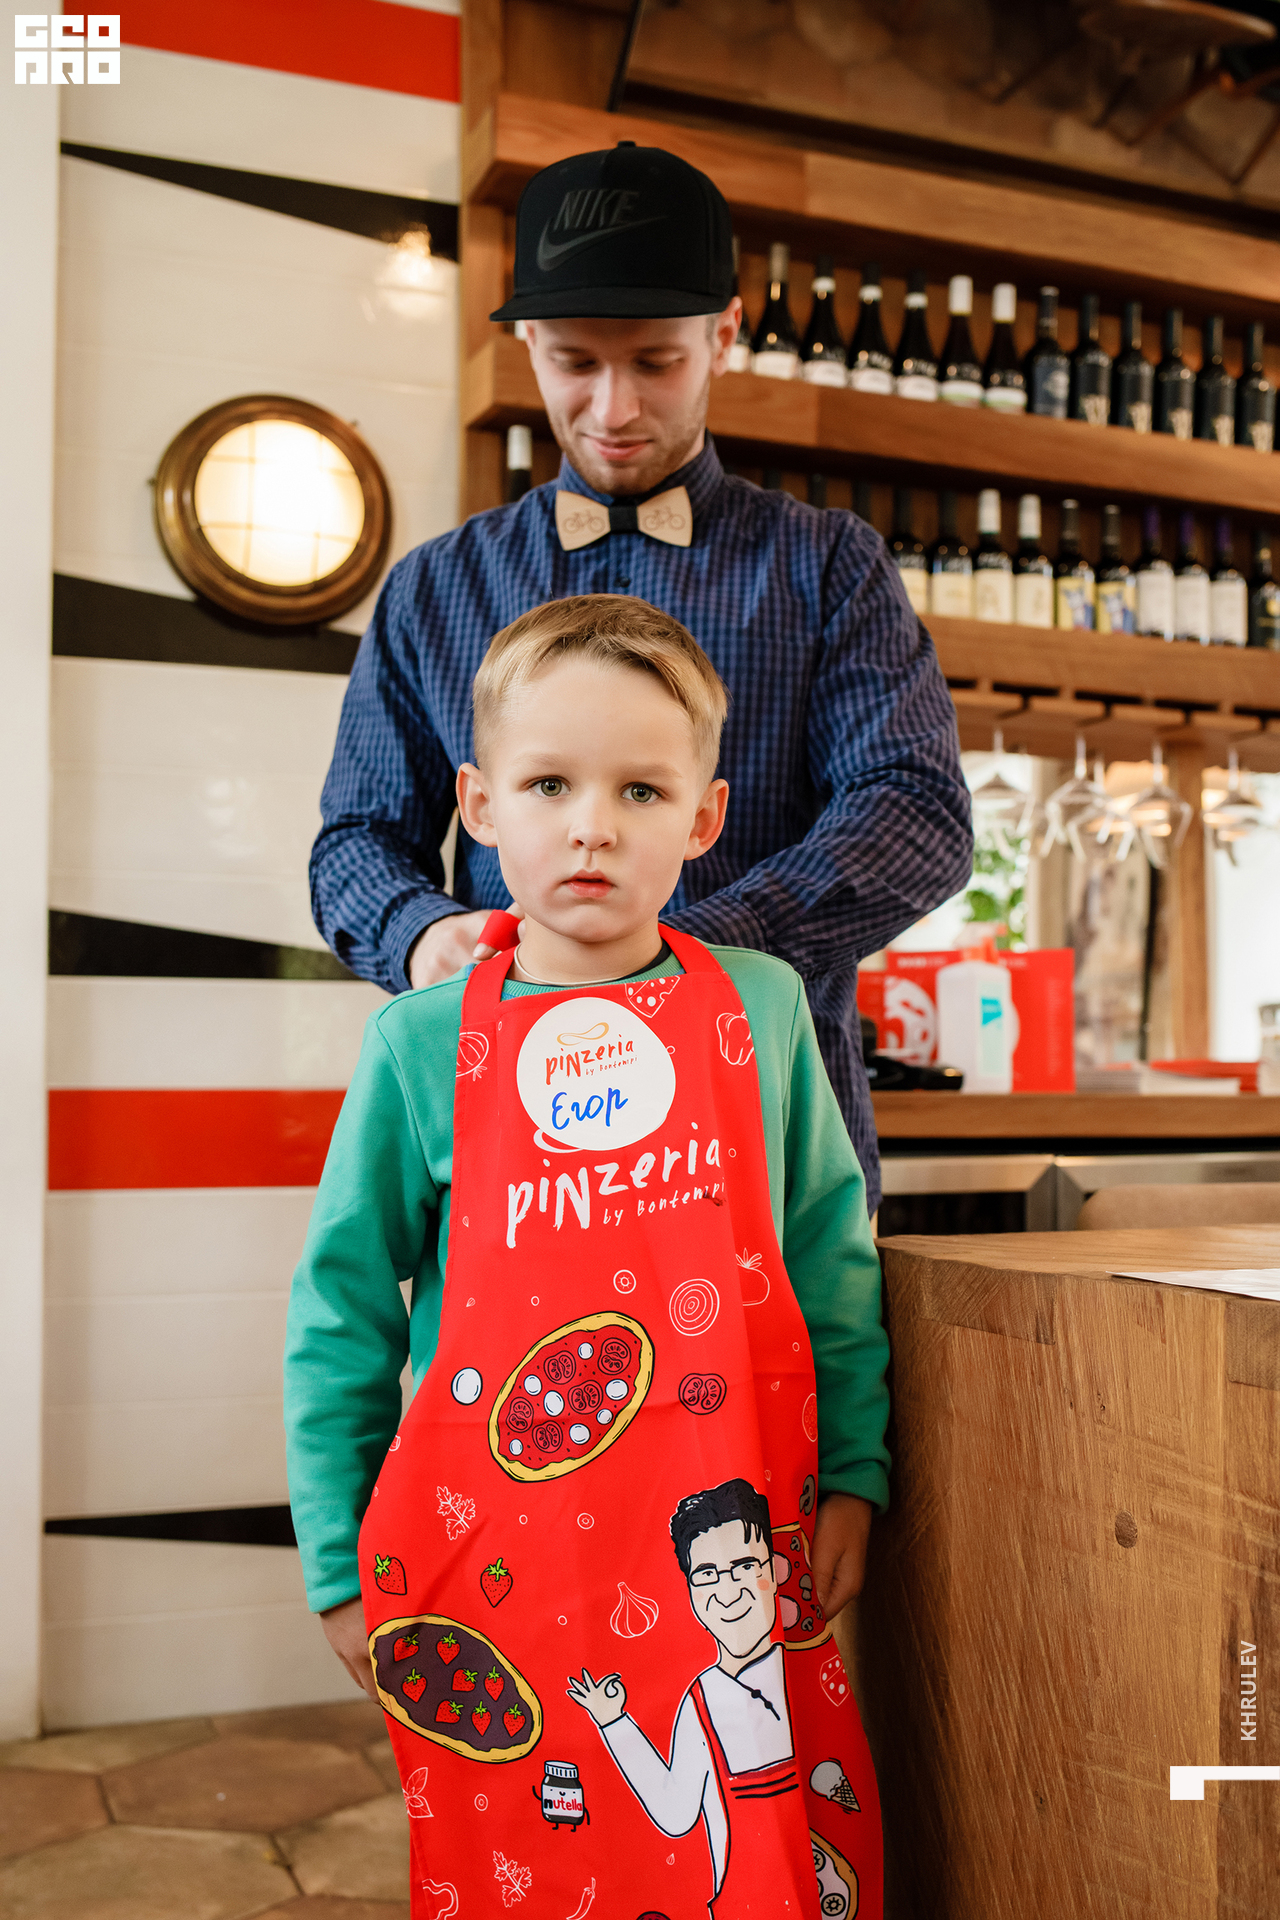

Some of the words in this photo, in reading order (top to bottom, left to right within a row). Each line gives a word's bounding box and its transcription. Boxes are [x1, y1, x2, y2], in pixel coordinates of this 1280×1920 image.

[552, 189, 640, 231] NIKE
[585, 1068, 595, 1076] by
[599, 1055, 638, 1072] Bontempi
[551, 1087, 629, 1130] Егор
[603, 1208, 624, 1226] by
[543, 1797, 583, 1811] nutella
